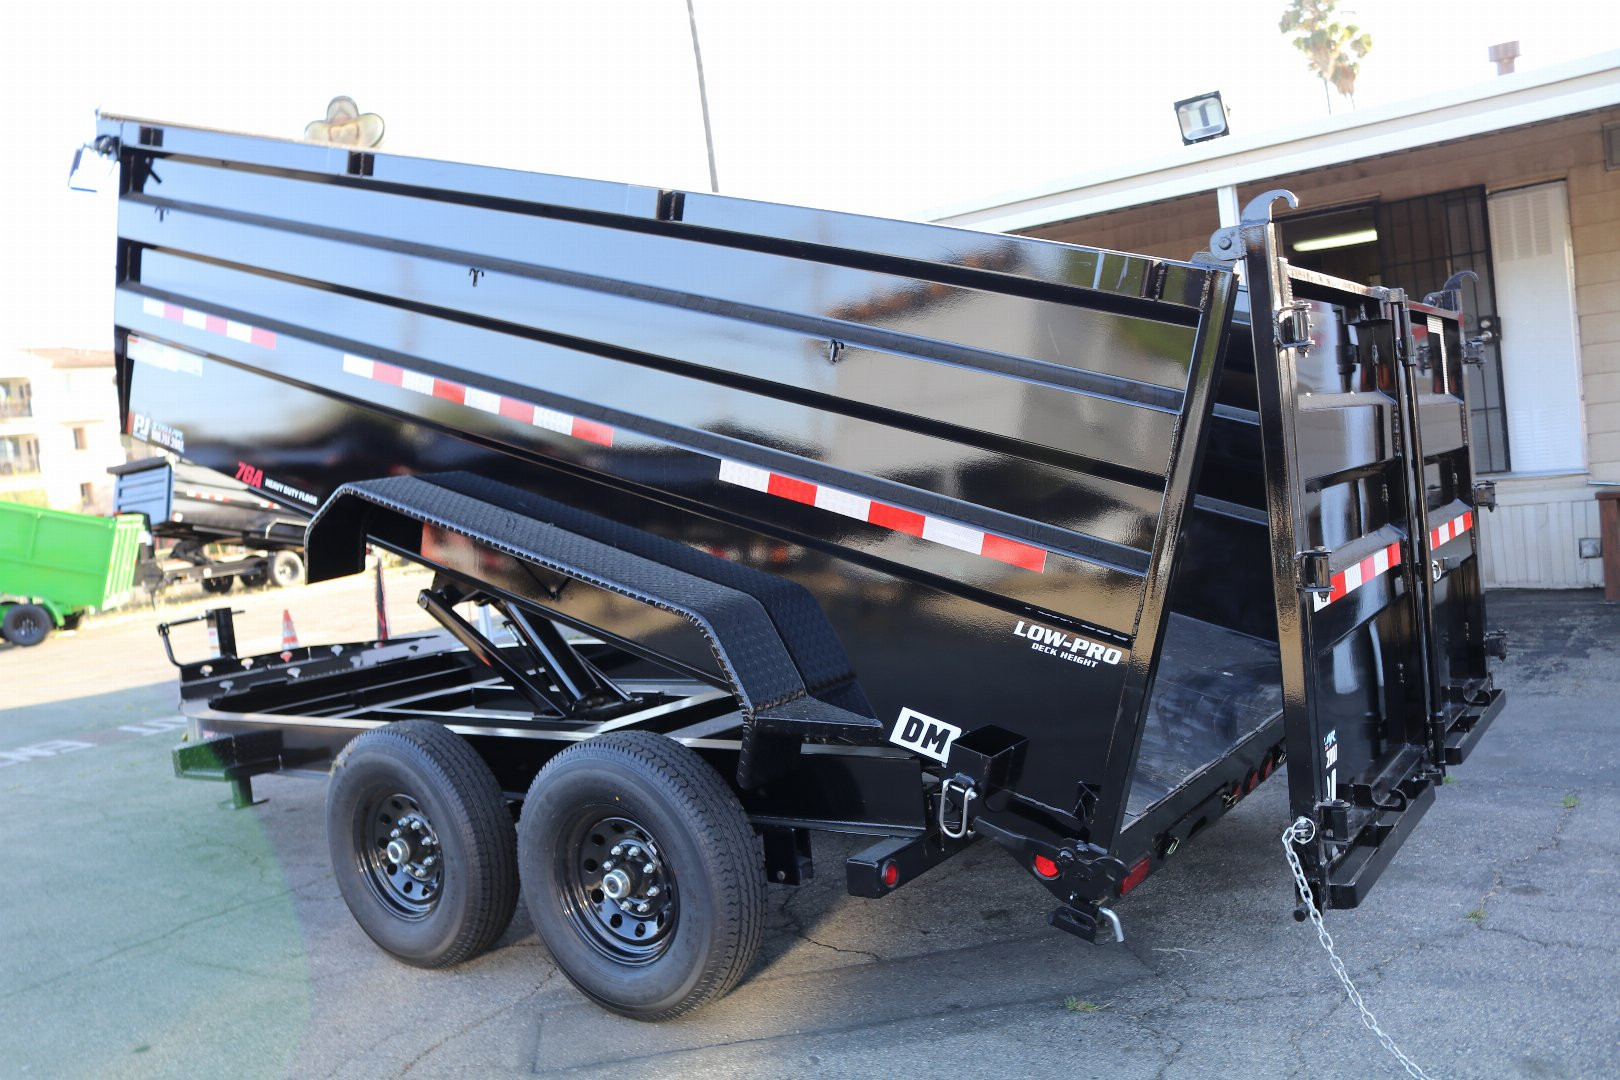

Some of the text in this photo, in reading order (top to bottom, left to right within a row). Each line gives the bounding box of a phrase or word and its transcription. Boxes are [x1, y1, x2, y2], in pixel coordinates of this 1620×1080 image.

[132, 413, 151, 435] PJ
[265, 478, 285, 493] HEAVY
[283, 485, 301, 499] DUTY
[299, 491, 318, 506] FLOOR
[1013, 620, 1123, 665] LOW-PRO
[1031, 642, 1099, 668] DECK HEIGHT
[900, 715, 951, 755] DM
